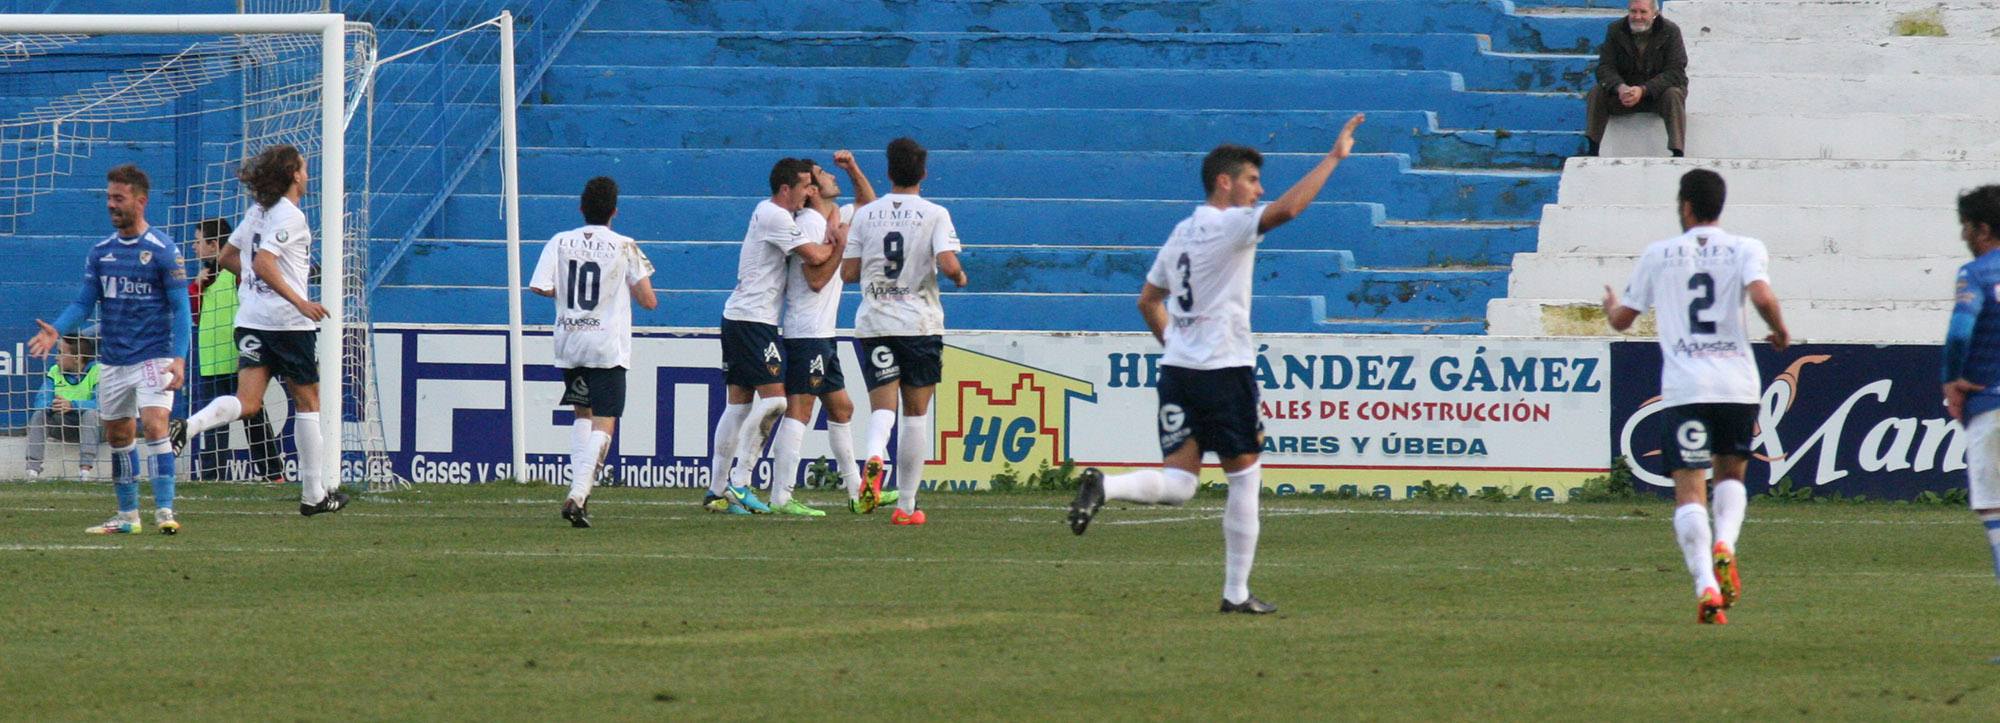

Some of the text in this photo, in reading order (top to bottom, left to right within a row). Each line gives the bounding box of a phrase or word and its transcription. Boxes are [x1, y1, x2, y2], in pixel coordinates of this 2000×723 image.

[868, 209, 924, 220] LUMEN
[559, 238, 617, 251] LUMEN
[882, 231, 904, 279] 9
[1664, 245, 1736, 258] LUMEN
[567, 259, 601, 311] 10
[1176, 252, 1194, 312] 3
[1687, 273, 1716, 334] 2
[1107, 344, 1602, 393] HEÁNDEZ GÁMEZ
[1319, 401, 1351, 420] DE
[1356, 398, 1551, 422] CONSTRUCCIÓN
[962, 416, 1037, 463] HG
[1351, 437, 1372, 455] Y
[1381, 432, 1489, 456] ÚBEDA
[411, 455, 471, 484] Gases
